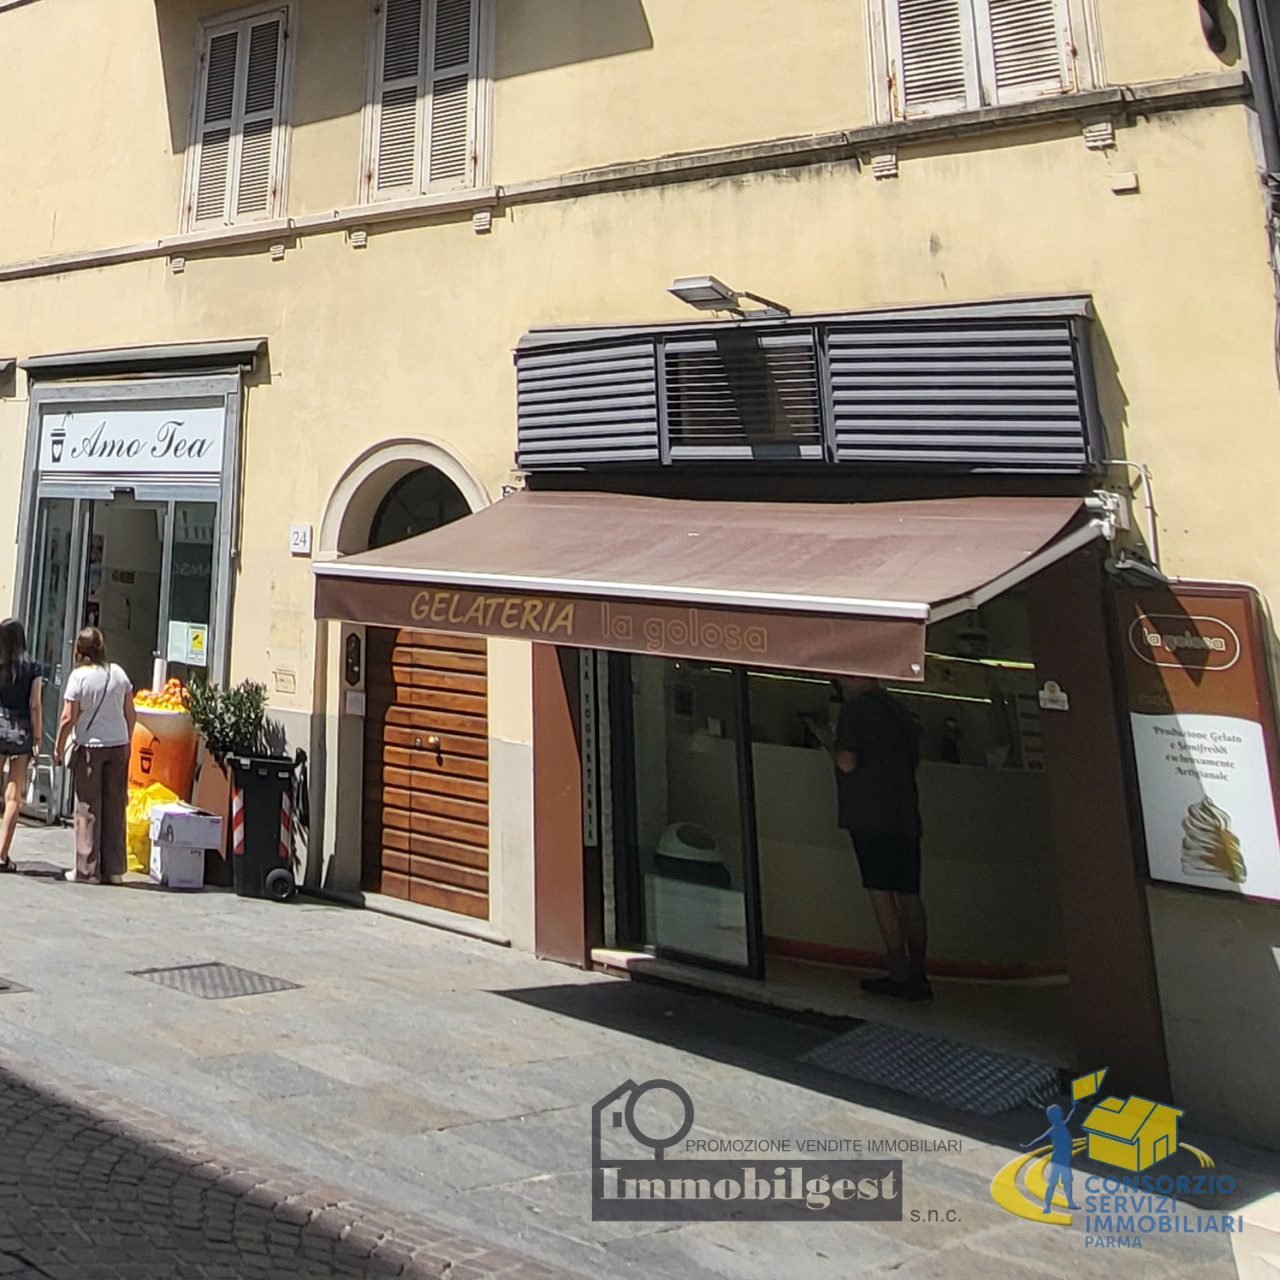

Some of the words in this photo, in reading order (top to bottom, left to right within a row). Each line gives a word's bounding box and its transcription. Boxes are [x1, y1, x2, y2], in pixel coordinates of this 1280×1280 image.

[71, 420, 149, 459] Amo
[150, 420, 215, 459] Tea
[292, 531, 308, 547] 24
[410, 591, 575, 636] GELATERIA
[601, 602, 633, 640] la
[643, 608, 768, 653] golosa
[1142, 627, 1162, 647] la
[1164, 630, 1226, 653] golosa
[1153, 726, 1207, 738] Produzione
[1210, 732, 1242, 743] Gelato
[1169, 742, 1177, 750] e
[1178, 741, 1227, 754] Semifreddi
[1176, 766, 1228, 781] Artigianale
